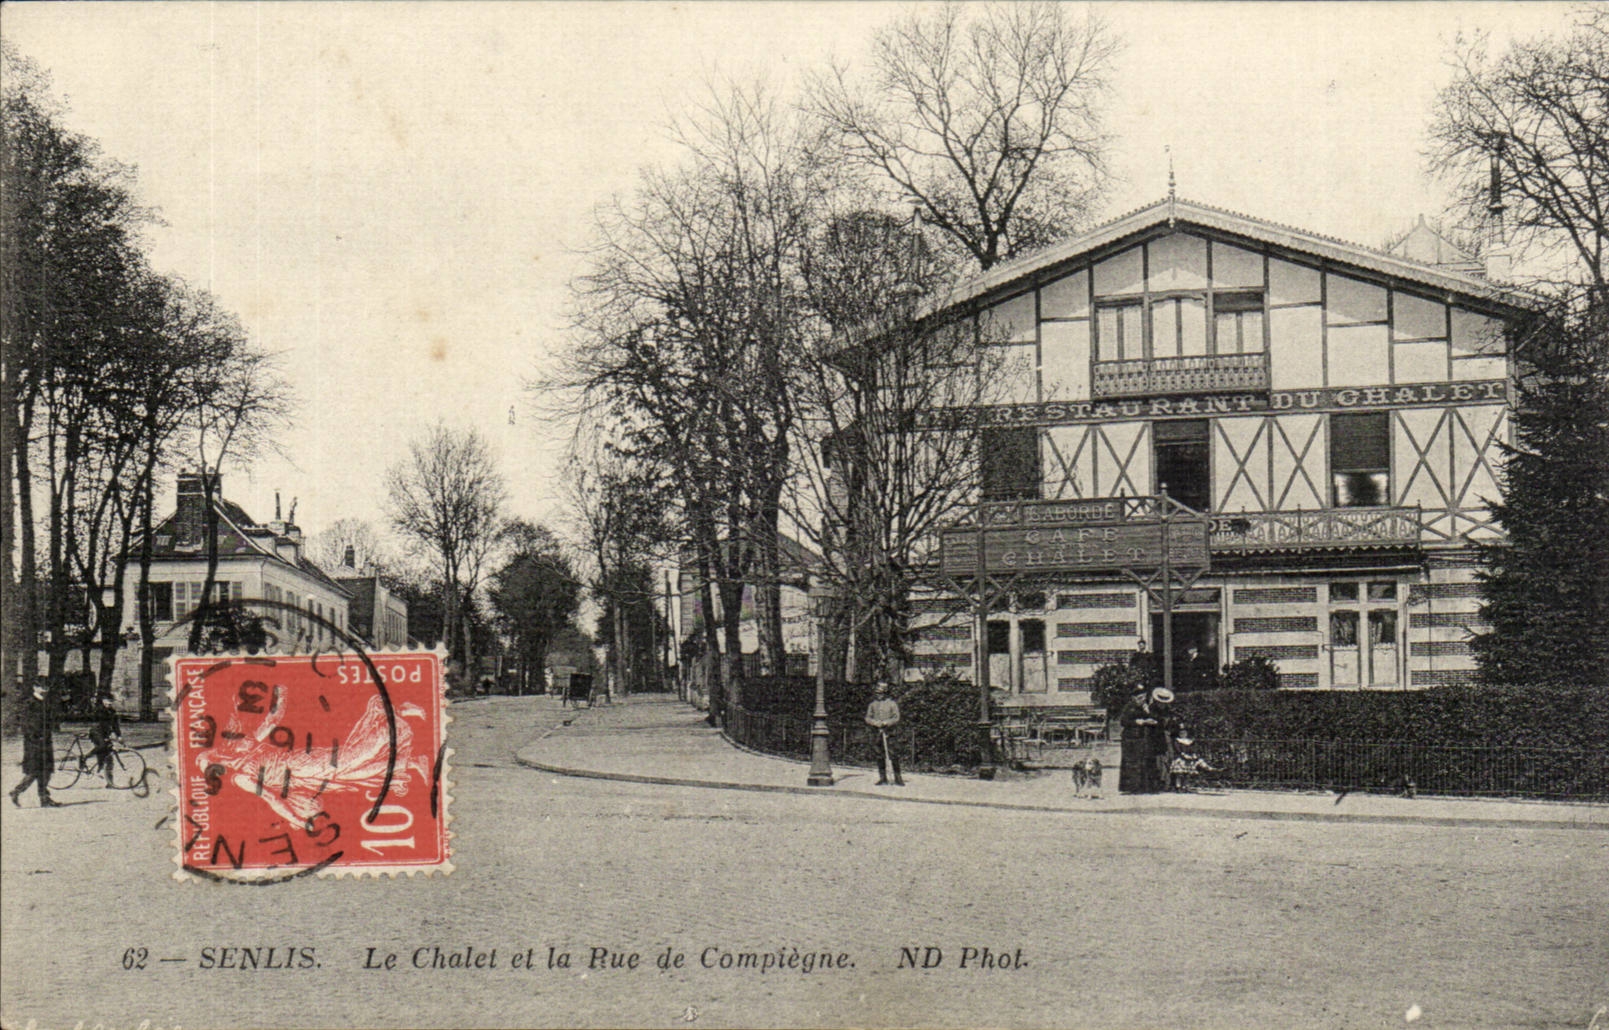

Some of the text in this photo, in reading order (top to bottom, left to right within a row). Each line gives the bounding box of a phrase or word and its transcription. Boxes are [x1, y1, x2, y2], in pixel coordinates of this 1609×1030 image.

[992, 396, 1255, 423] RESTAURANT
[1272, 391, 1321, 410] DU
[1335, 382, 1505, 407] CHALET
[1002, 547, 1146, 567] CHALET
[337, 665, 421, 684] POSTES
